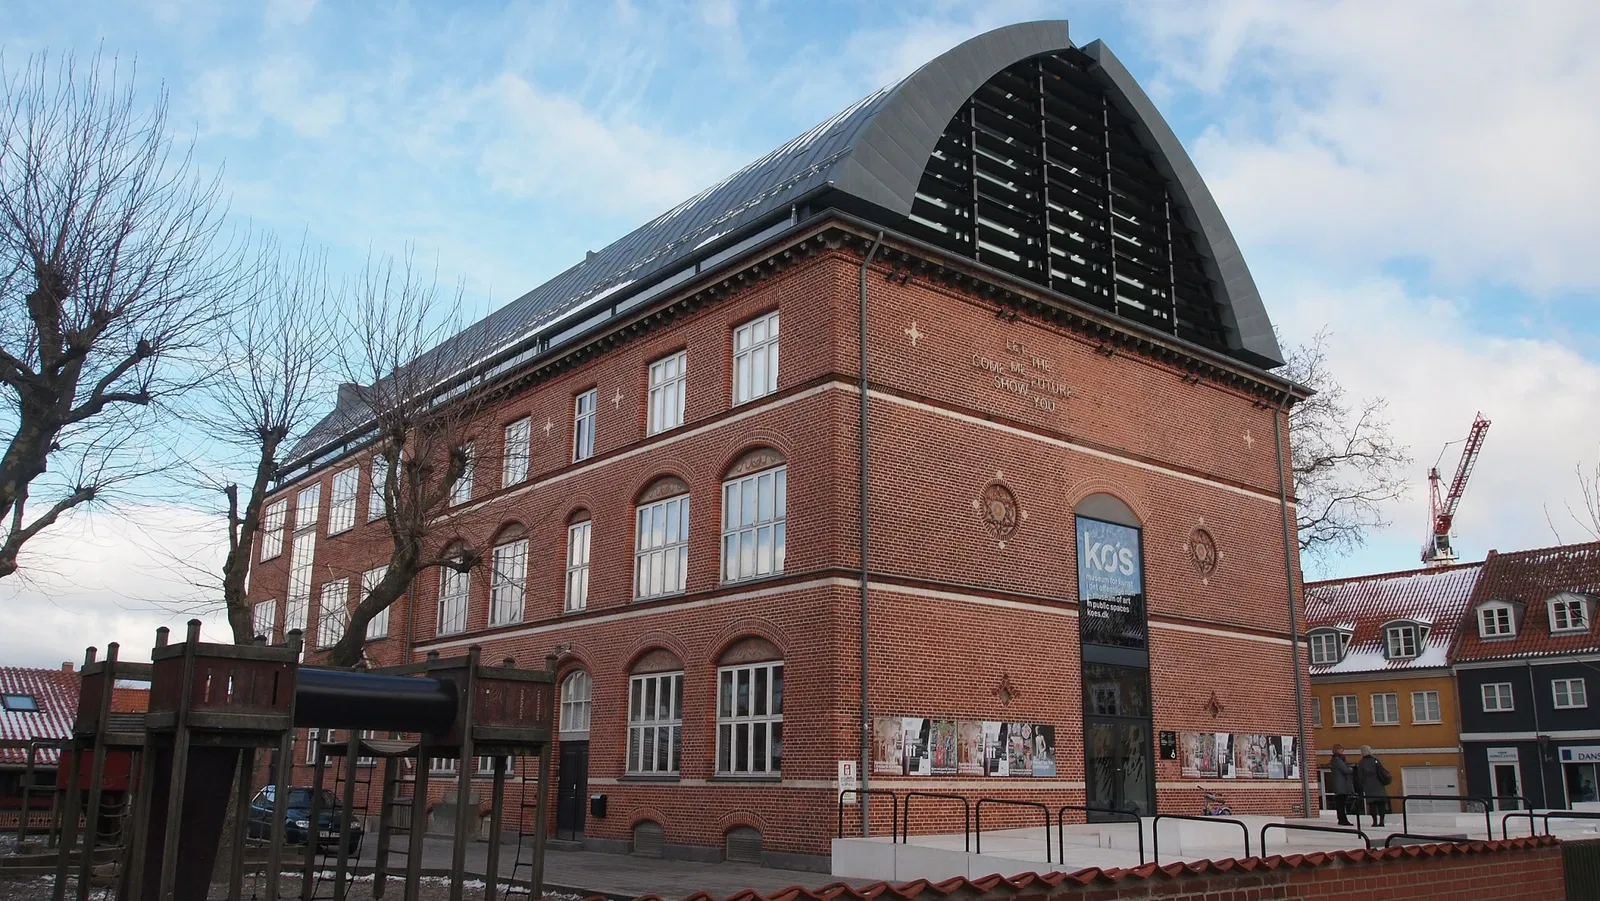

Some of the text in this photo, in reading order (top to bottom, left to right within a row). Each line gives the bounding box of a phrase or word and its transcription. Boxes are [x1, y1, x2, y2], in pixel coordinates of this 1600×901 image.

[972, 353, 1005, 375] COME
[994, 375, 1073, 399] SHOW FUTURE
[1032, 396, 1056, 412] YOU
[1085, 574, 1109, 585] museum
[1093, 601, 1109, 610] public
[1110, 604, 1130, 613] spaces
[1123, 597, 1131, 605] art
[1087, 608, 1110, 618] koes.dk
